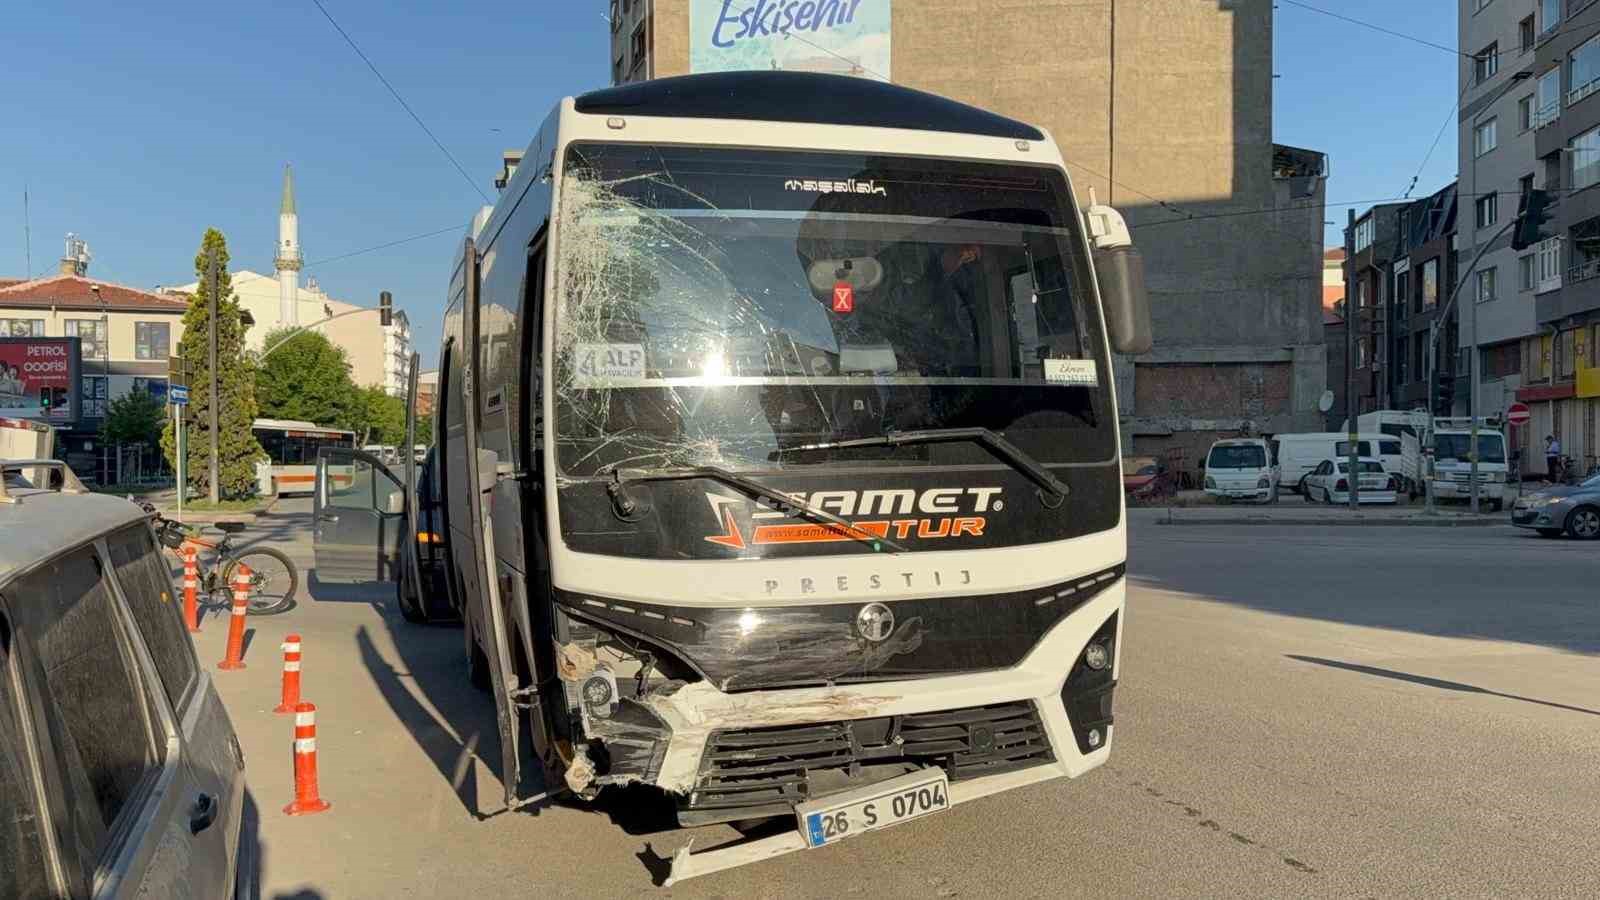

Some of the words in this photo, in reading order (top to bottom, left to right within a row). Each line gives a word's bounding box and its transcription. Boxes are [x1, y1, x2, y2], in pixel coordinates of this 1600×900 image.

[27, 345, 67, 357] PETROL
[601, 349, 641, 367] ALP
[892, 517, 986, 539] TUR
[823, 811, 849, 838] 26
[863, 803, 878, 827] S
[892, 784, 945, 818] 0704
